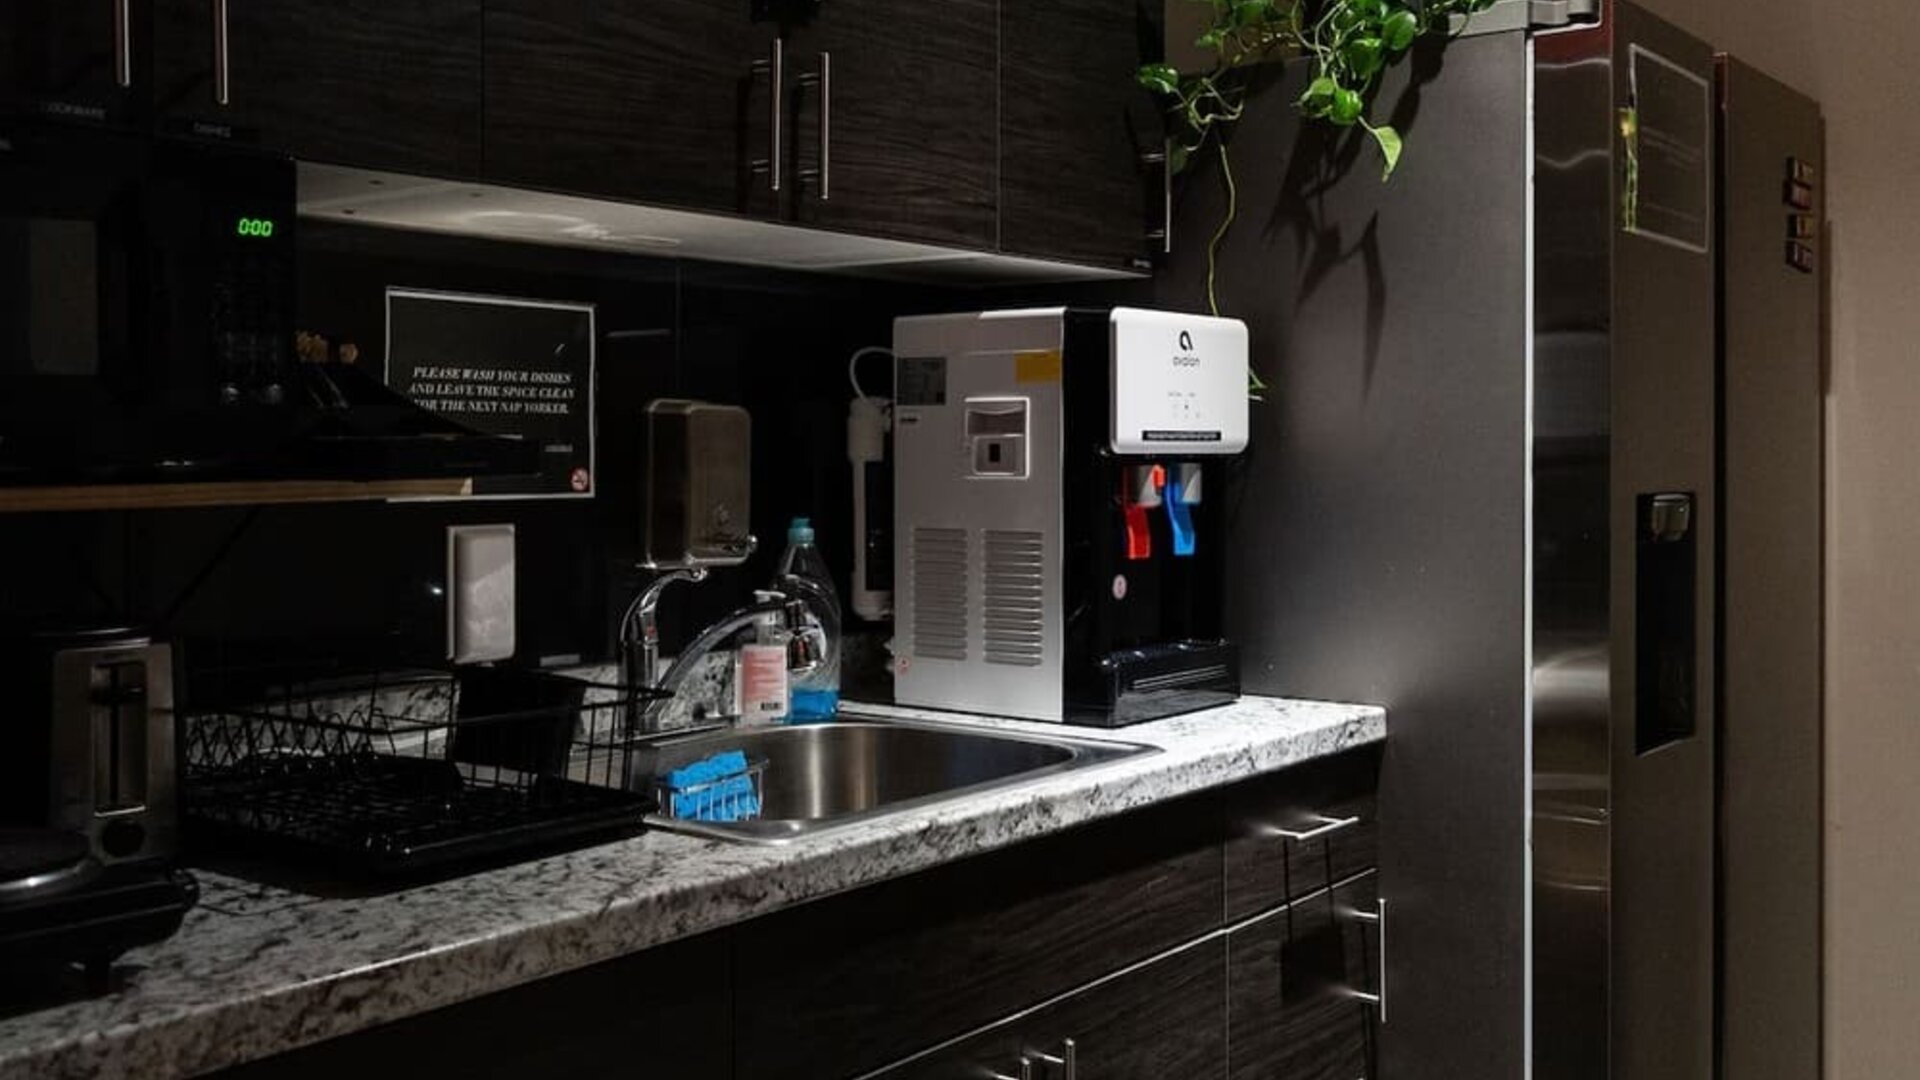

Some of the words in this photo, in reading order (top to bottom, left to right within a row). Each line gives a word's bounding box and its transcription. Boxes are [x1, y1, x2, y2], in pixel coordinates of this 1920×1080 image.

[239, 217, 273, 237] 0:00
[413, 366, 461, 379] PLEASE
[462, 368, 495, 380] WASH
[497, 369, 529, 382] YOUR
[530, 371, 572, 384] DISHES
[408, 382, 435, 395] AND
[436, 384, 476, 396] LEAVE
[477, 385, 500, 397] THE
[538, 387, 575, 399] CLEAN
[440, 400, 466, 412] THE
[468, 401, 498, 413] NEXT
